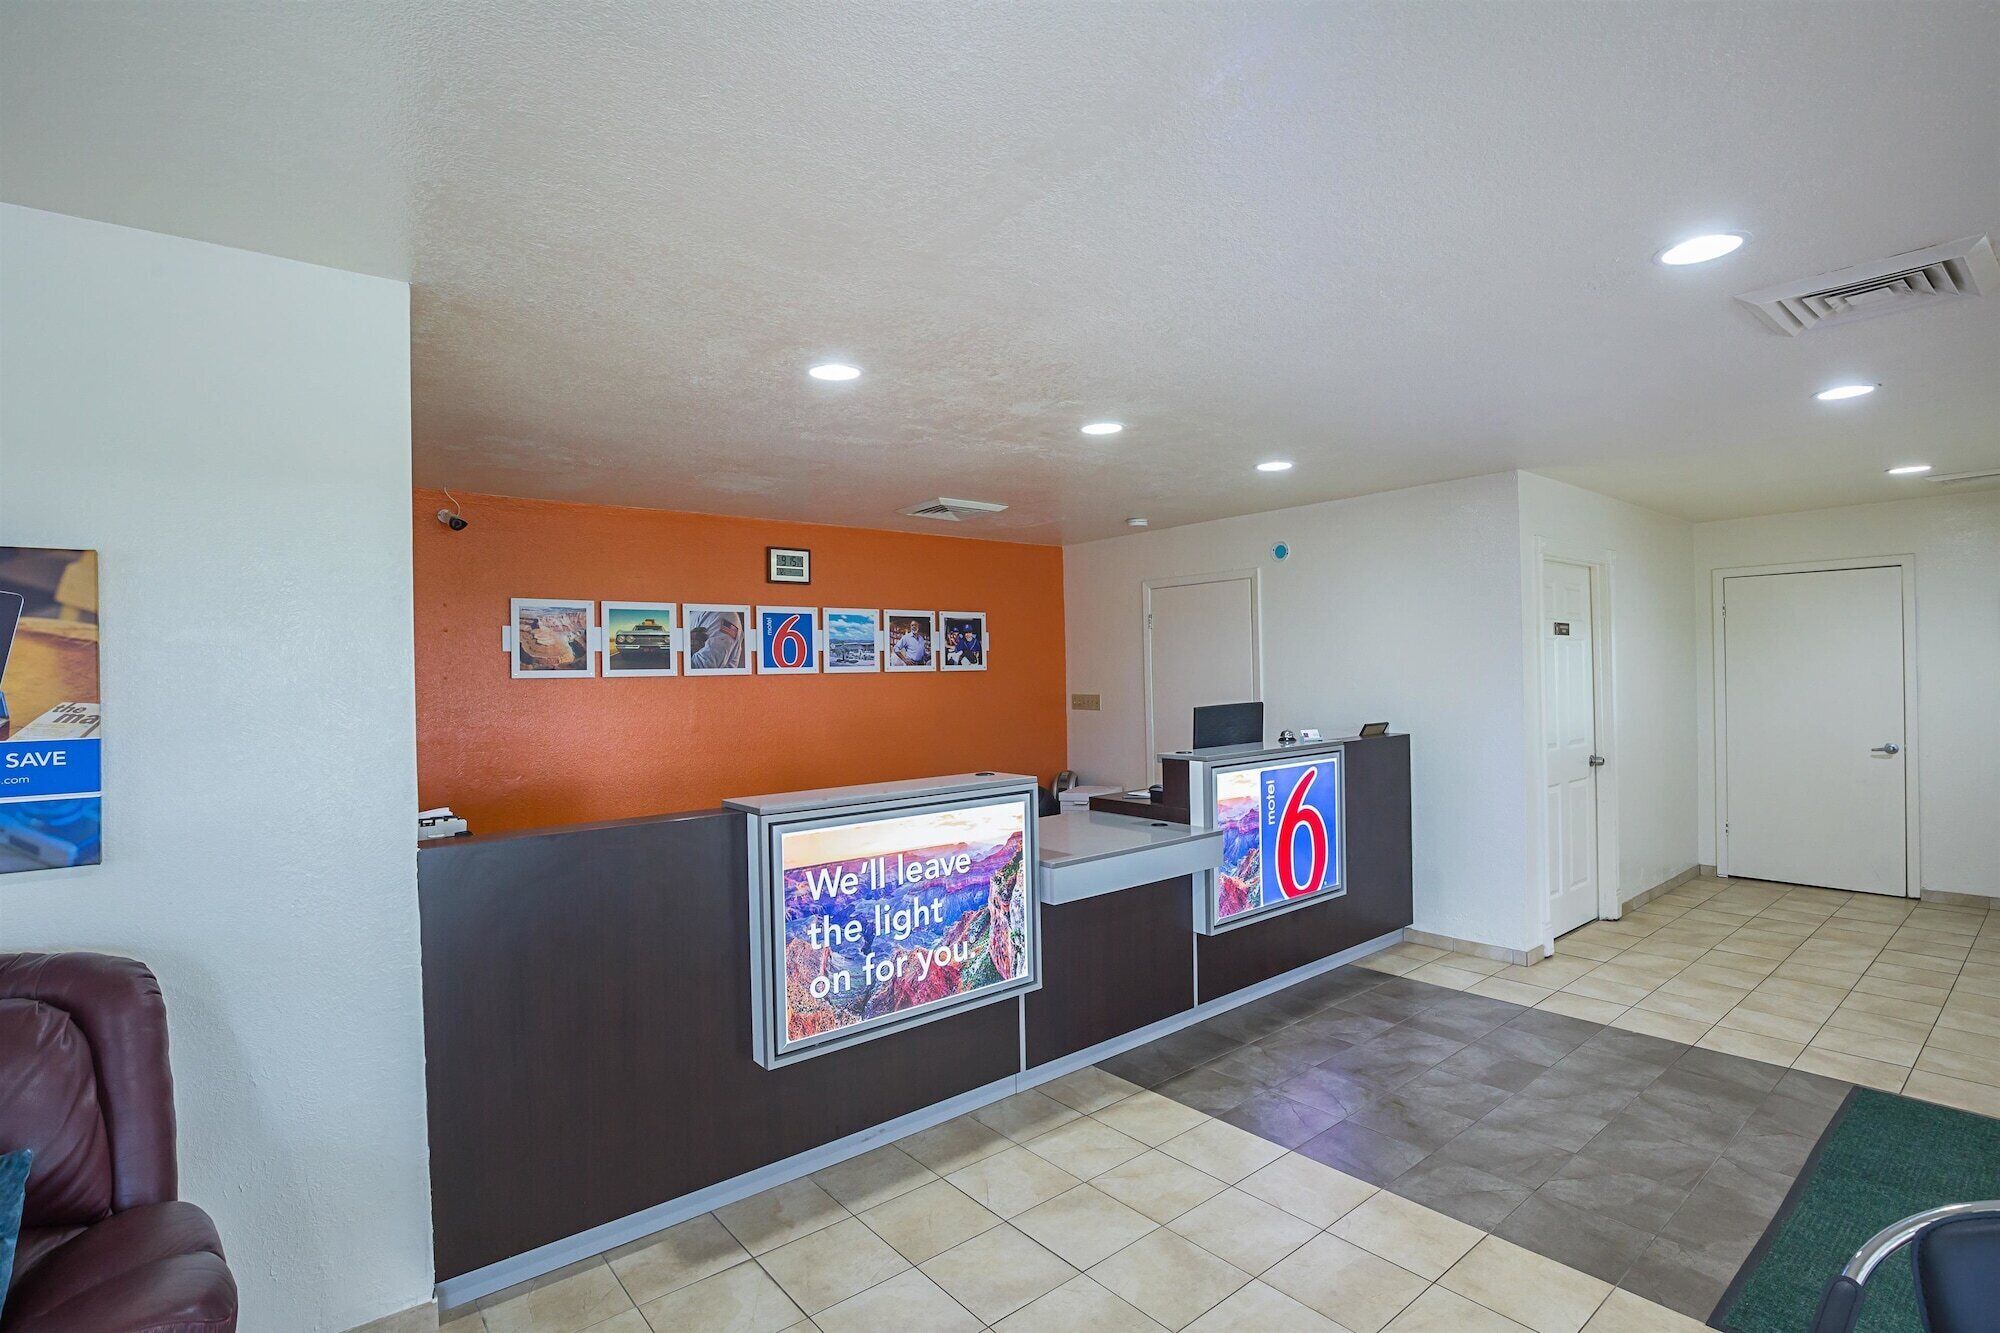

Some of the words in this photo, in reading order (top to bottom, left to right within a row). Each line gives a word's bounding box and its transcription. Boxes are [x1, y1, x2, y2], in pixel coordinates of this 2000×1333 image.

[765, 617, 773, 637] motel
[772, 614, 808, 669] 6
[53, 702, 87, 713] the
[6, 751, 67, 768] SAVE
[1266, 780, 1276, 825] motel
[1275, 766, 1329, 899] 6
[805, 857, 885, 902] We'll
[897, 853, 971, 885] leave
[807, 915, 862, 950] the
[874, 897, 943, 941] light
[810, 971, 850, 999] on
[862, 952, 908, 986] for
[917, 941, 976, 981] you.
